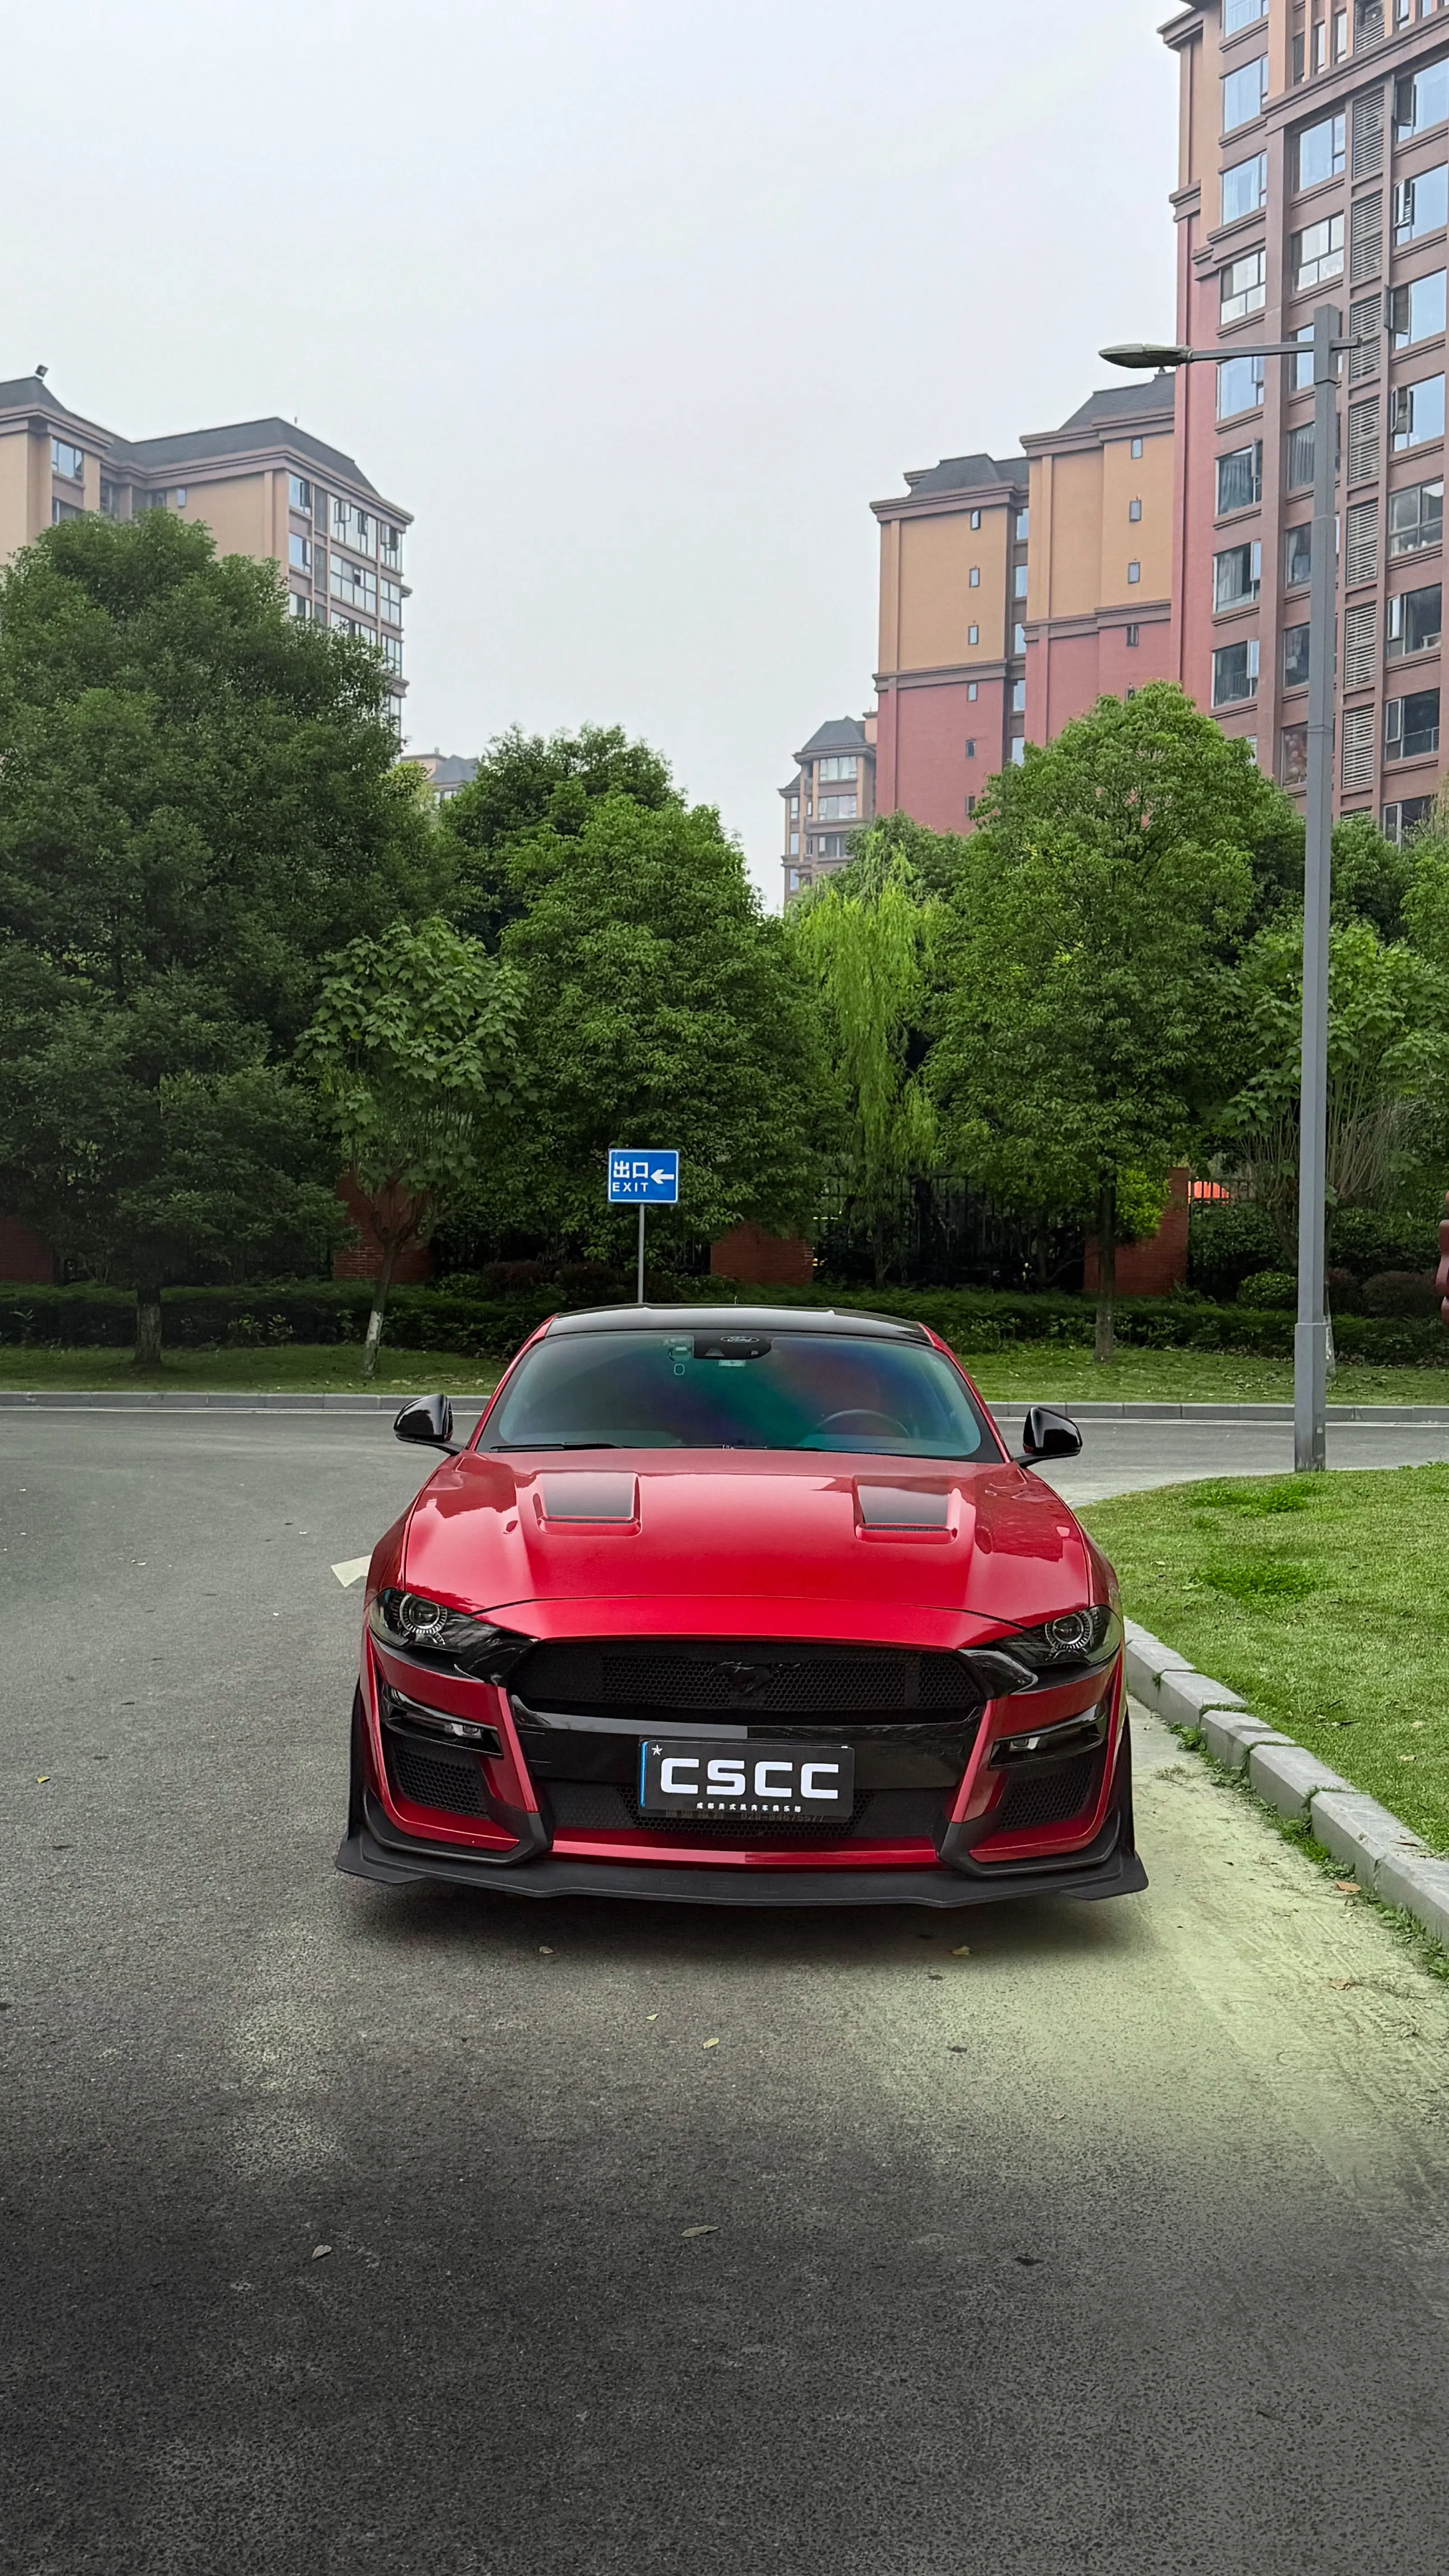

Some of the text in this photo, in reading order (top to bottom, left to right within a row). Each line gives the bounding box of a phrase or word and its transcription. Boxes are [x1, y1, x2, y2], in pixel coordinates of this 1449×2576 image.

[613, 1160, 649, 1178] 出口
[612, 1182, 649, 1192] EXIT
[661, 1758, 839, 1799] CSCC
